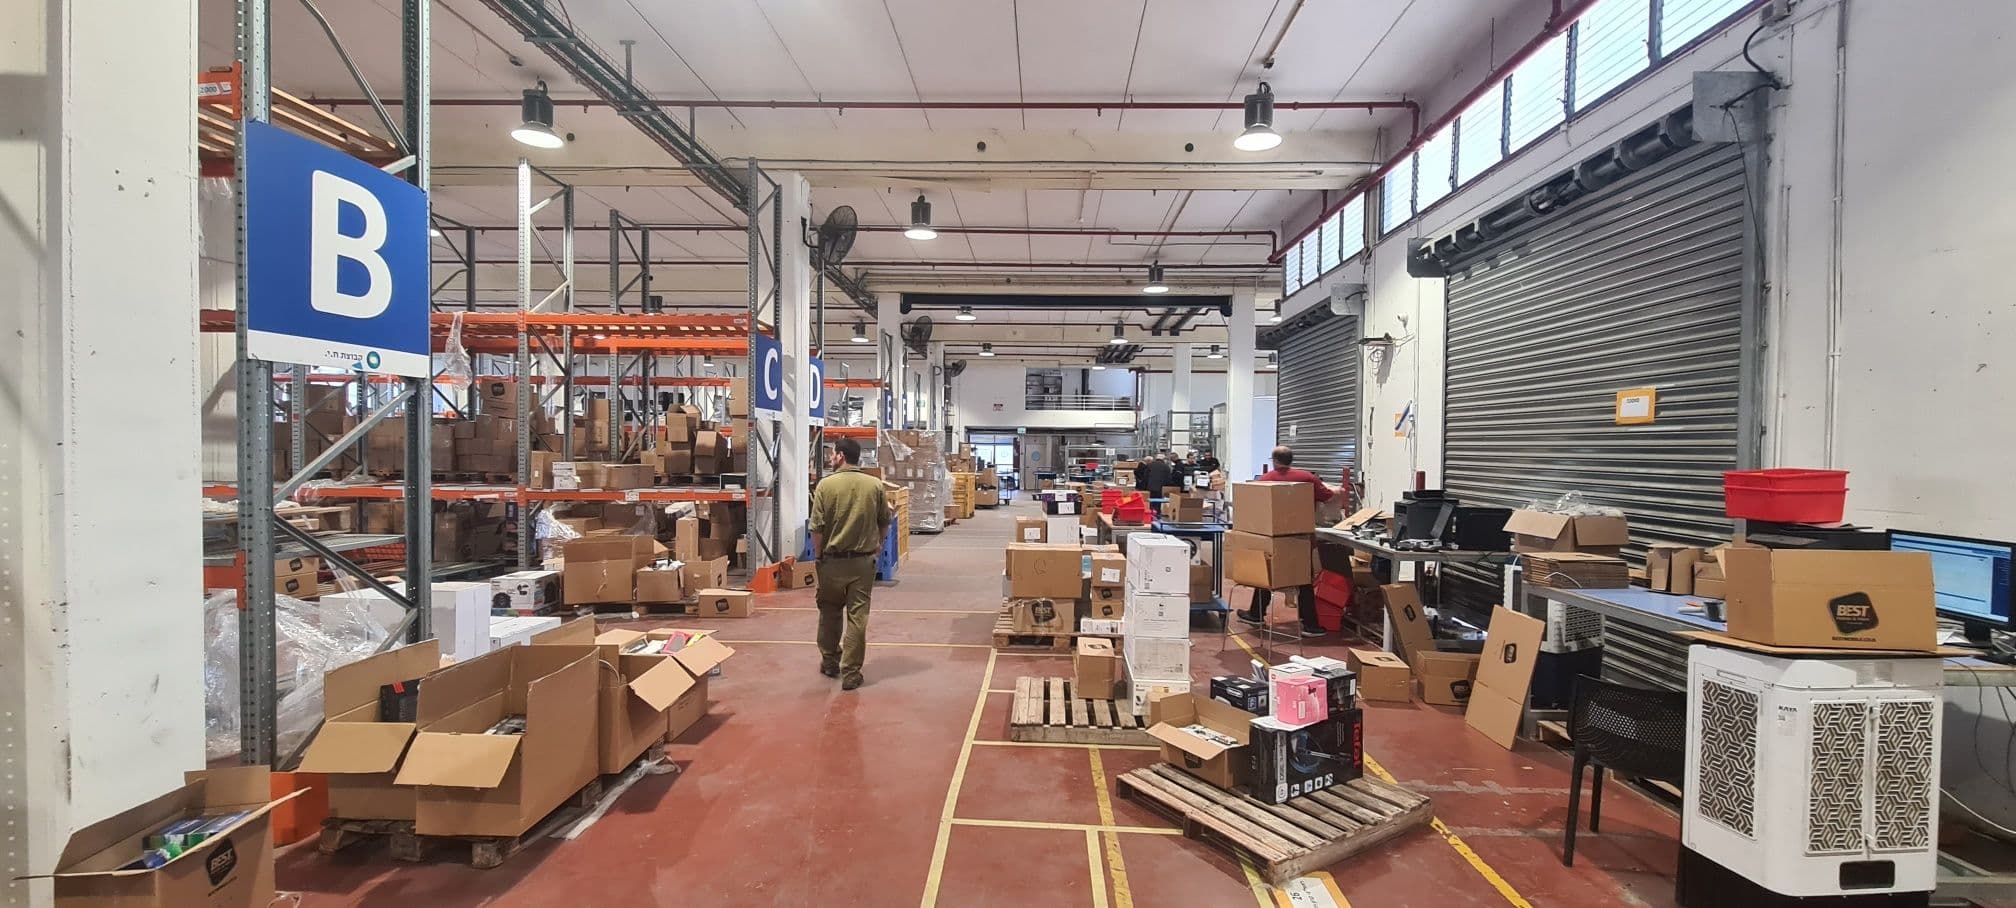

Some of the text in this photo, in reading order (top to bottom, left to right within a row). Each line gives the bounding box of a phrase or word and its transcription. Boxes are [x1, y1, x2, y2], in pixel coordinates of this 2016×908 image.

[311, 169, 393, 319] B
[764, 347, 778, 401] C
[809, 364, 821, 410] D
[1836, 604, 1870, 617] BEST
[210, 848, 233, 871] BEST
